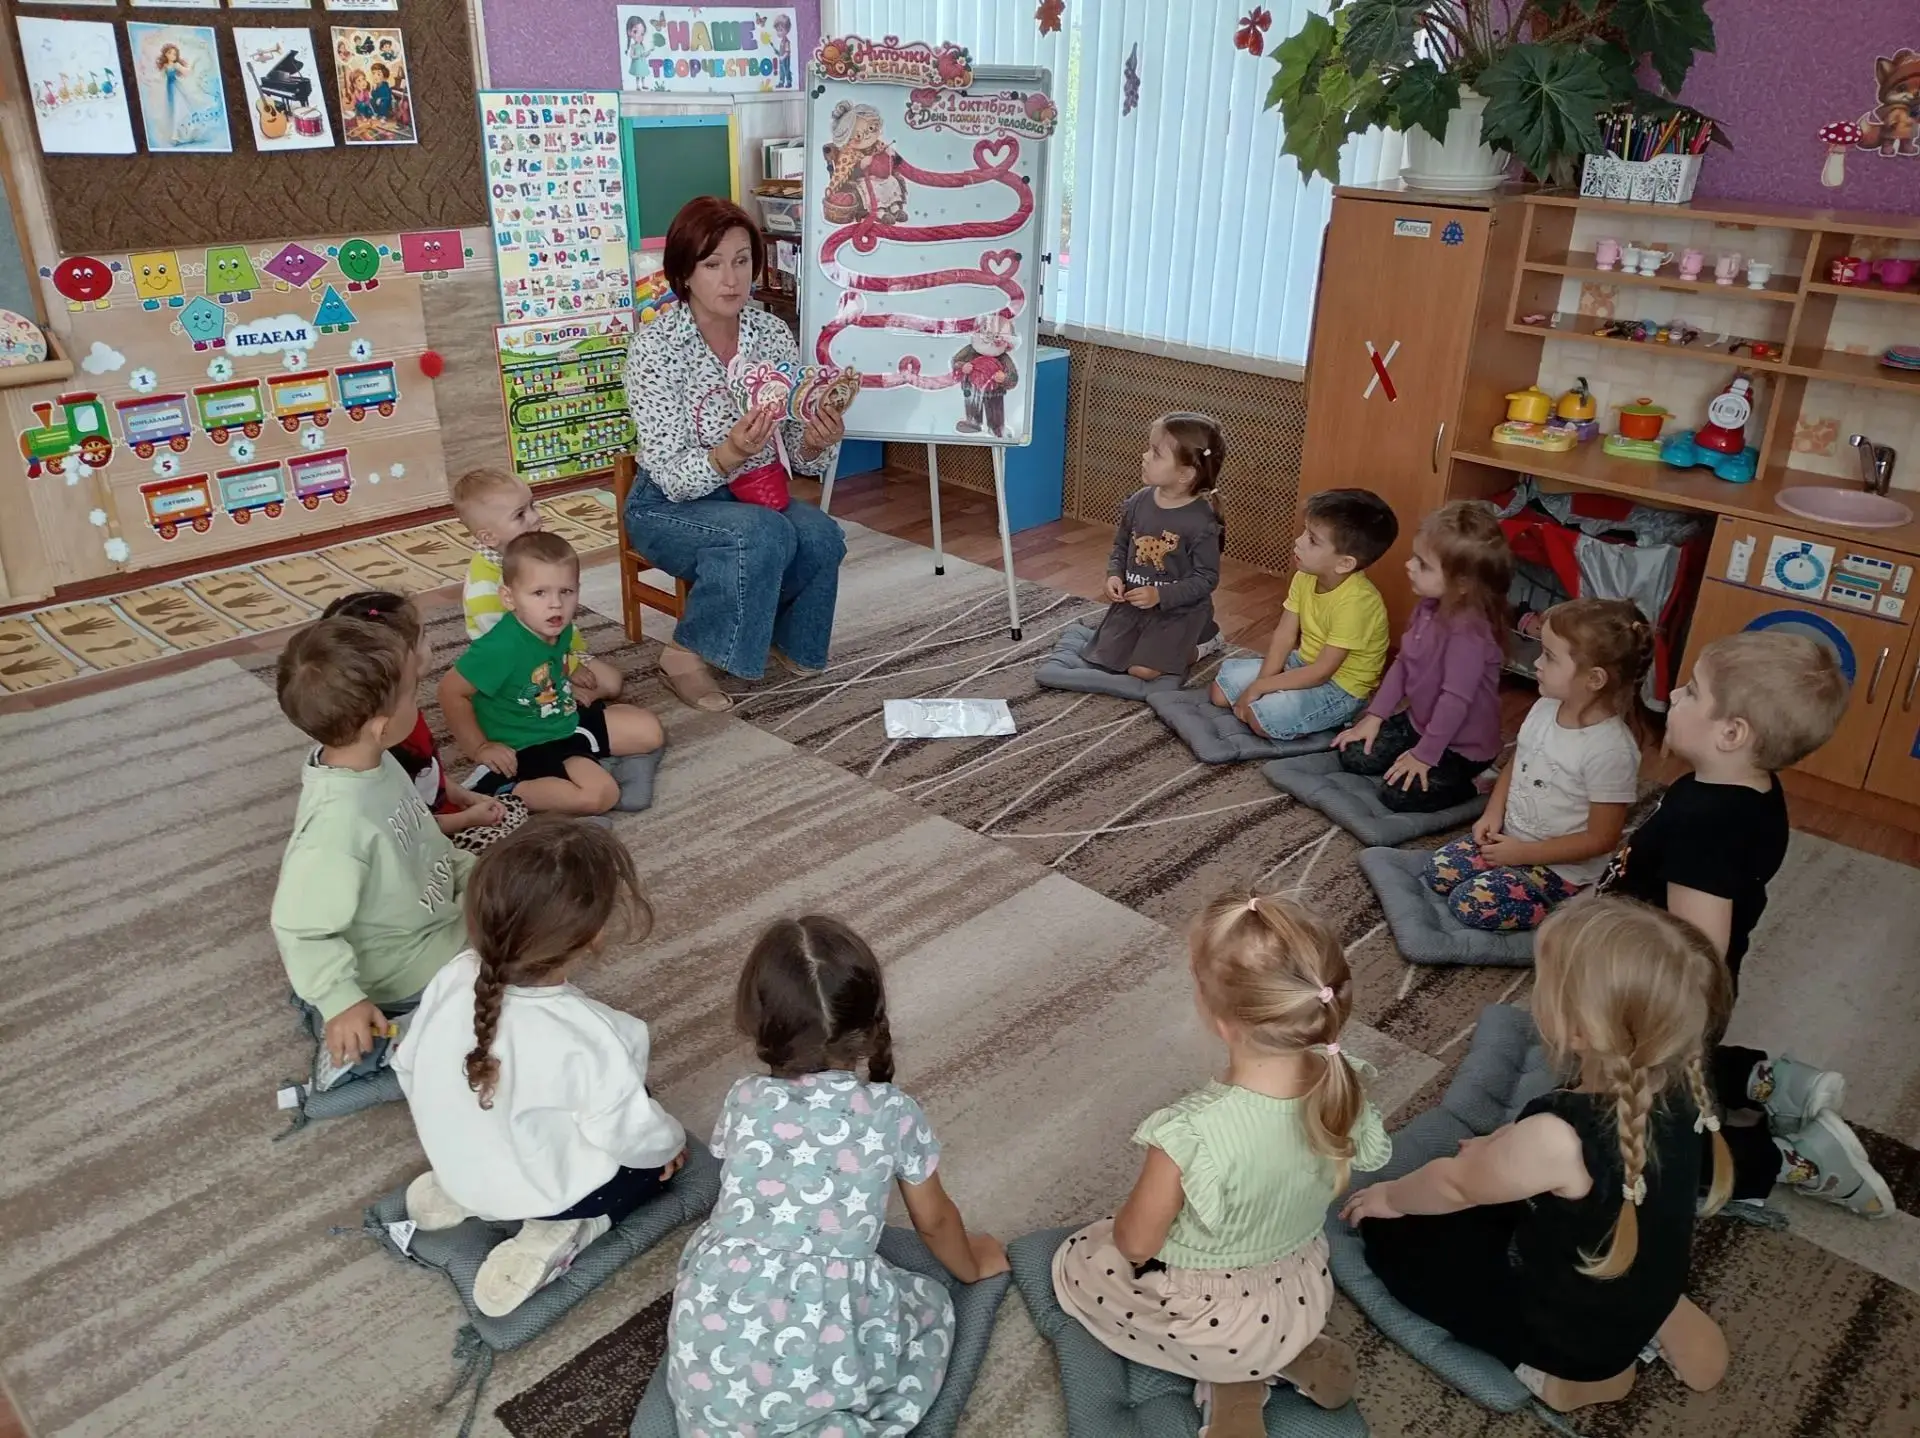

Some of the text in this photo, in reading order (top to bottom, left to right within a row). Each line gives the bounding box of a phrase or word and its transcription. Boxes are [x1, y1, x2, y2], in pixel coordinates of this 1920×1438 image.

[667, 21, 758, 51] НАШЕ
[853, 40, 931, 65] Ниточки
[648, 58, 779, 78] ТВОРЧЕСТВО!
[505, 93, 558, 106] АЛФАВИТ
[947, 94, 1018, 117] 1 октября
[486, 110, 498, 126] А
[516, 109, 526, 124] Б
[542, 109, 553, 123] В
[569, 109, 578, 124] Г
[918, 109, 947, 124] День
[998, 117, 1044, 134] человека
[488, 134, 498, 149] Е
[544, 132, 557, 147] Ж
[594, 131, 604, 145] И
[517, 158, 527, 172] К
[597, 155, 606, 168] Н
[492, 178, 606, 198] О П Р С Т
[548, 204, 560, 220] Х
[600, 201, 609, 215] Ч
[498, 231, 512, 246] Ш
[519, 269, 629, 291] 1 2 3 4 5
[521, 300, 530, 312] 6
[547, 297, 556, 310] 7
[573, 295, 582, 308] 8
[617, 297, 630, 308] 10
[236, 328, 307, 347] НЕДЕЛЯ
[139, 344, 366, 386] 1 2 3 4
[162, 433, 317, 471] 5 6 7
